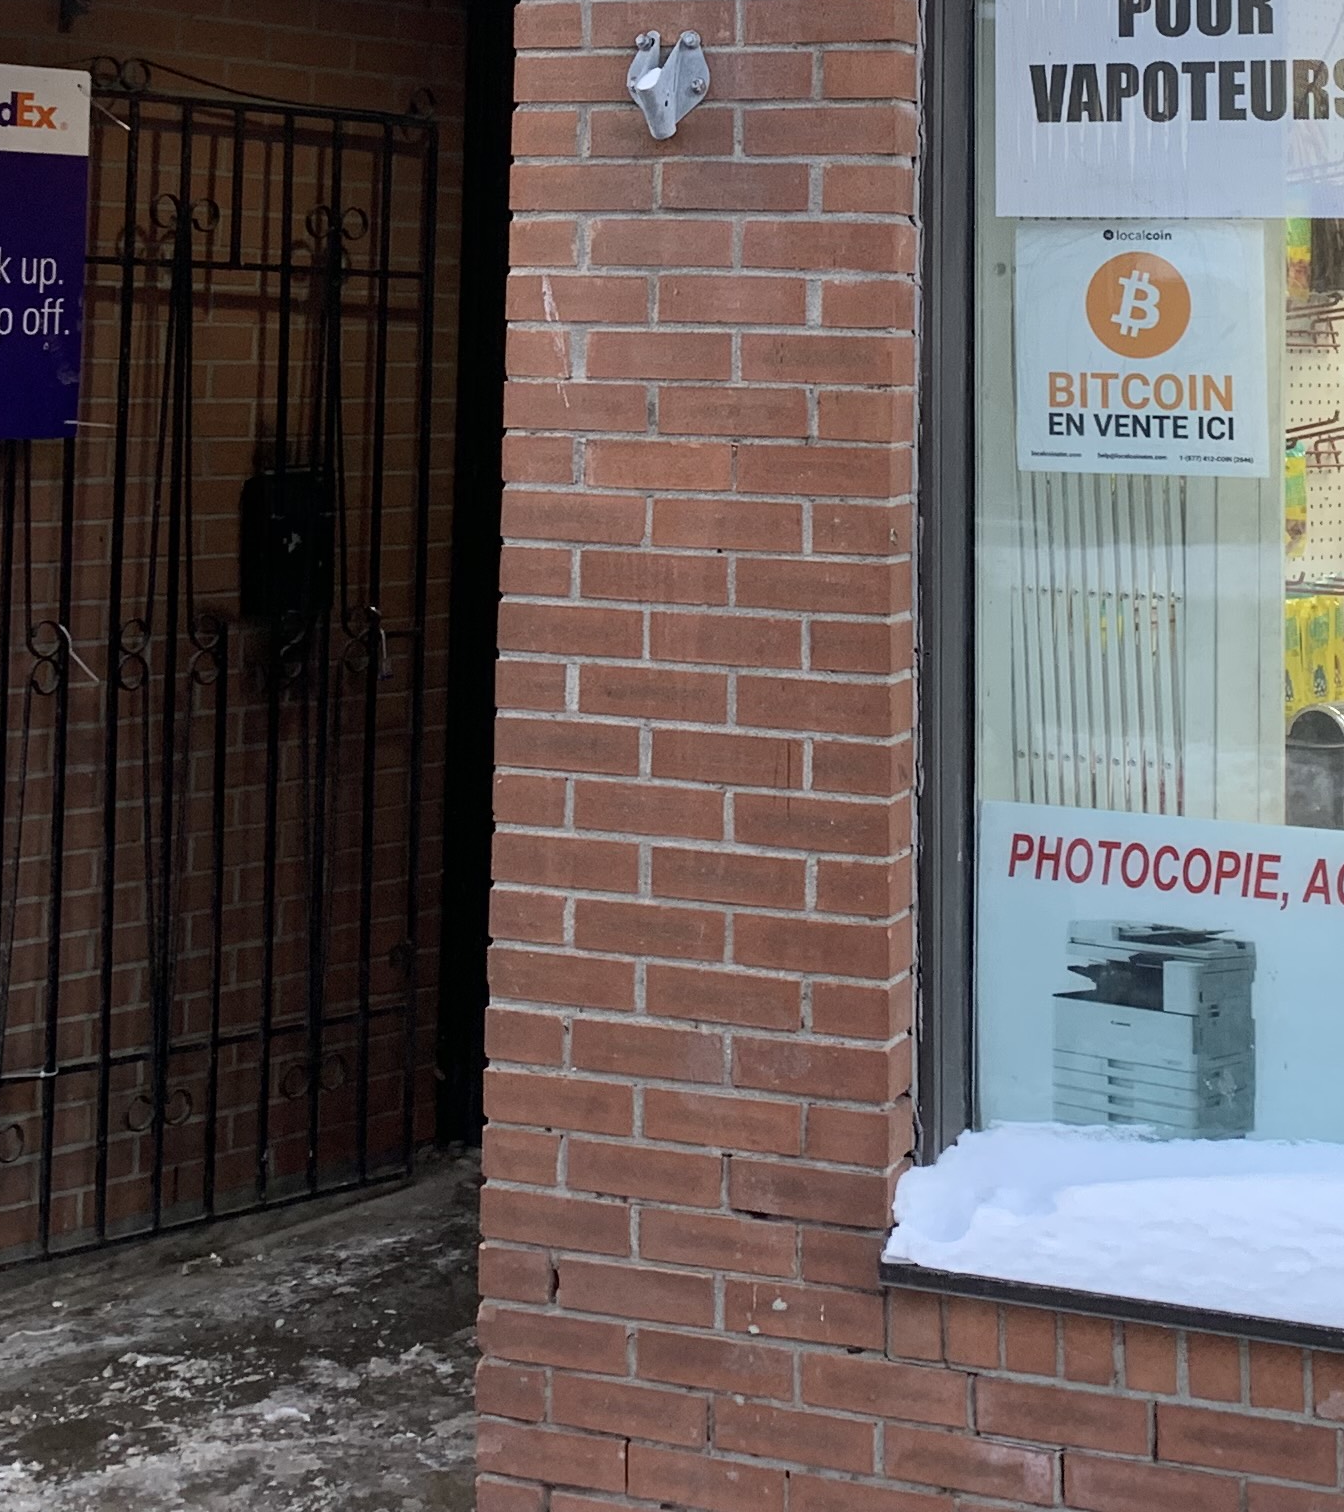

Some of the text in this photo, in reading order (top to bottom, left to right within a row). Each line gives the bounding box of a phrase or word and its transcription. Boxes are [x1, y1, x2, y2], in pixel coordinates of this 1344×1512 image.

[1116, 229, 1173, 242] localcoin
[20, 257, 64, 293] up.
[22, 298, 70, 336] off.
[1047, 371, 1234, 412] BITCOIN
[1048, 412, 1235, 441] EN VENTE ICI
[1007, 833, 1289, 911] PHOTOCOPIE,
